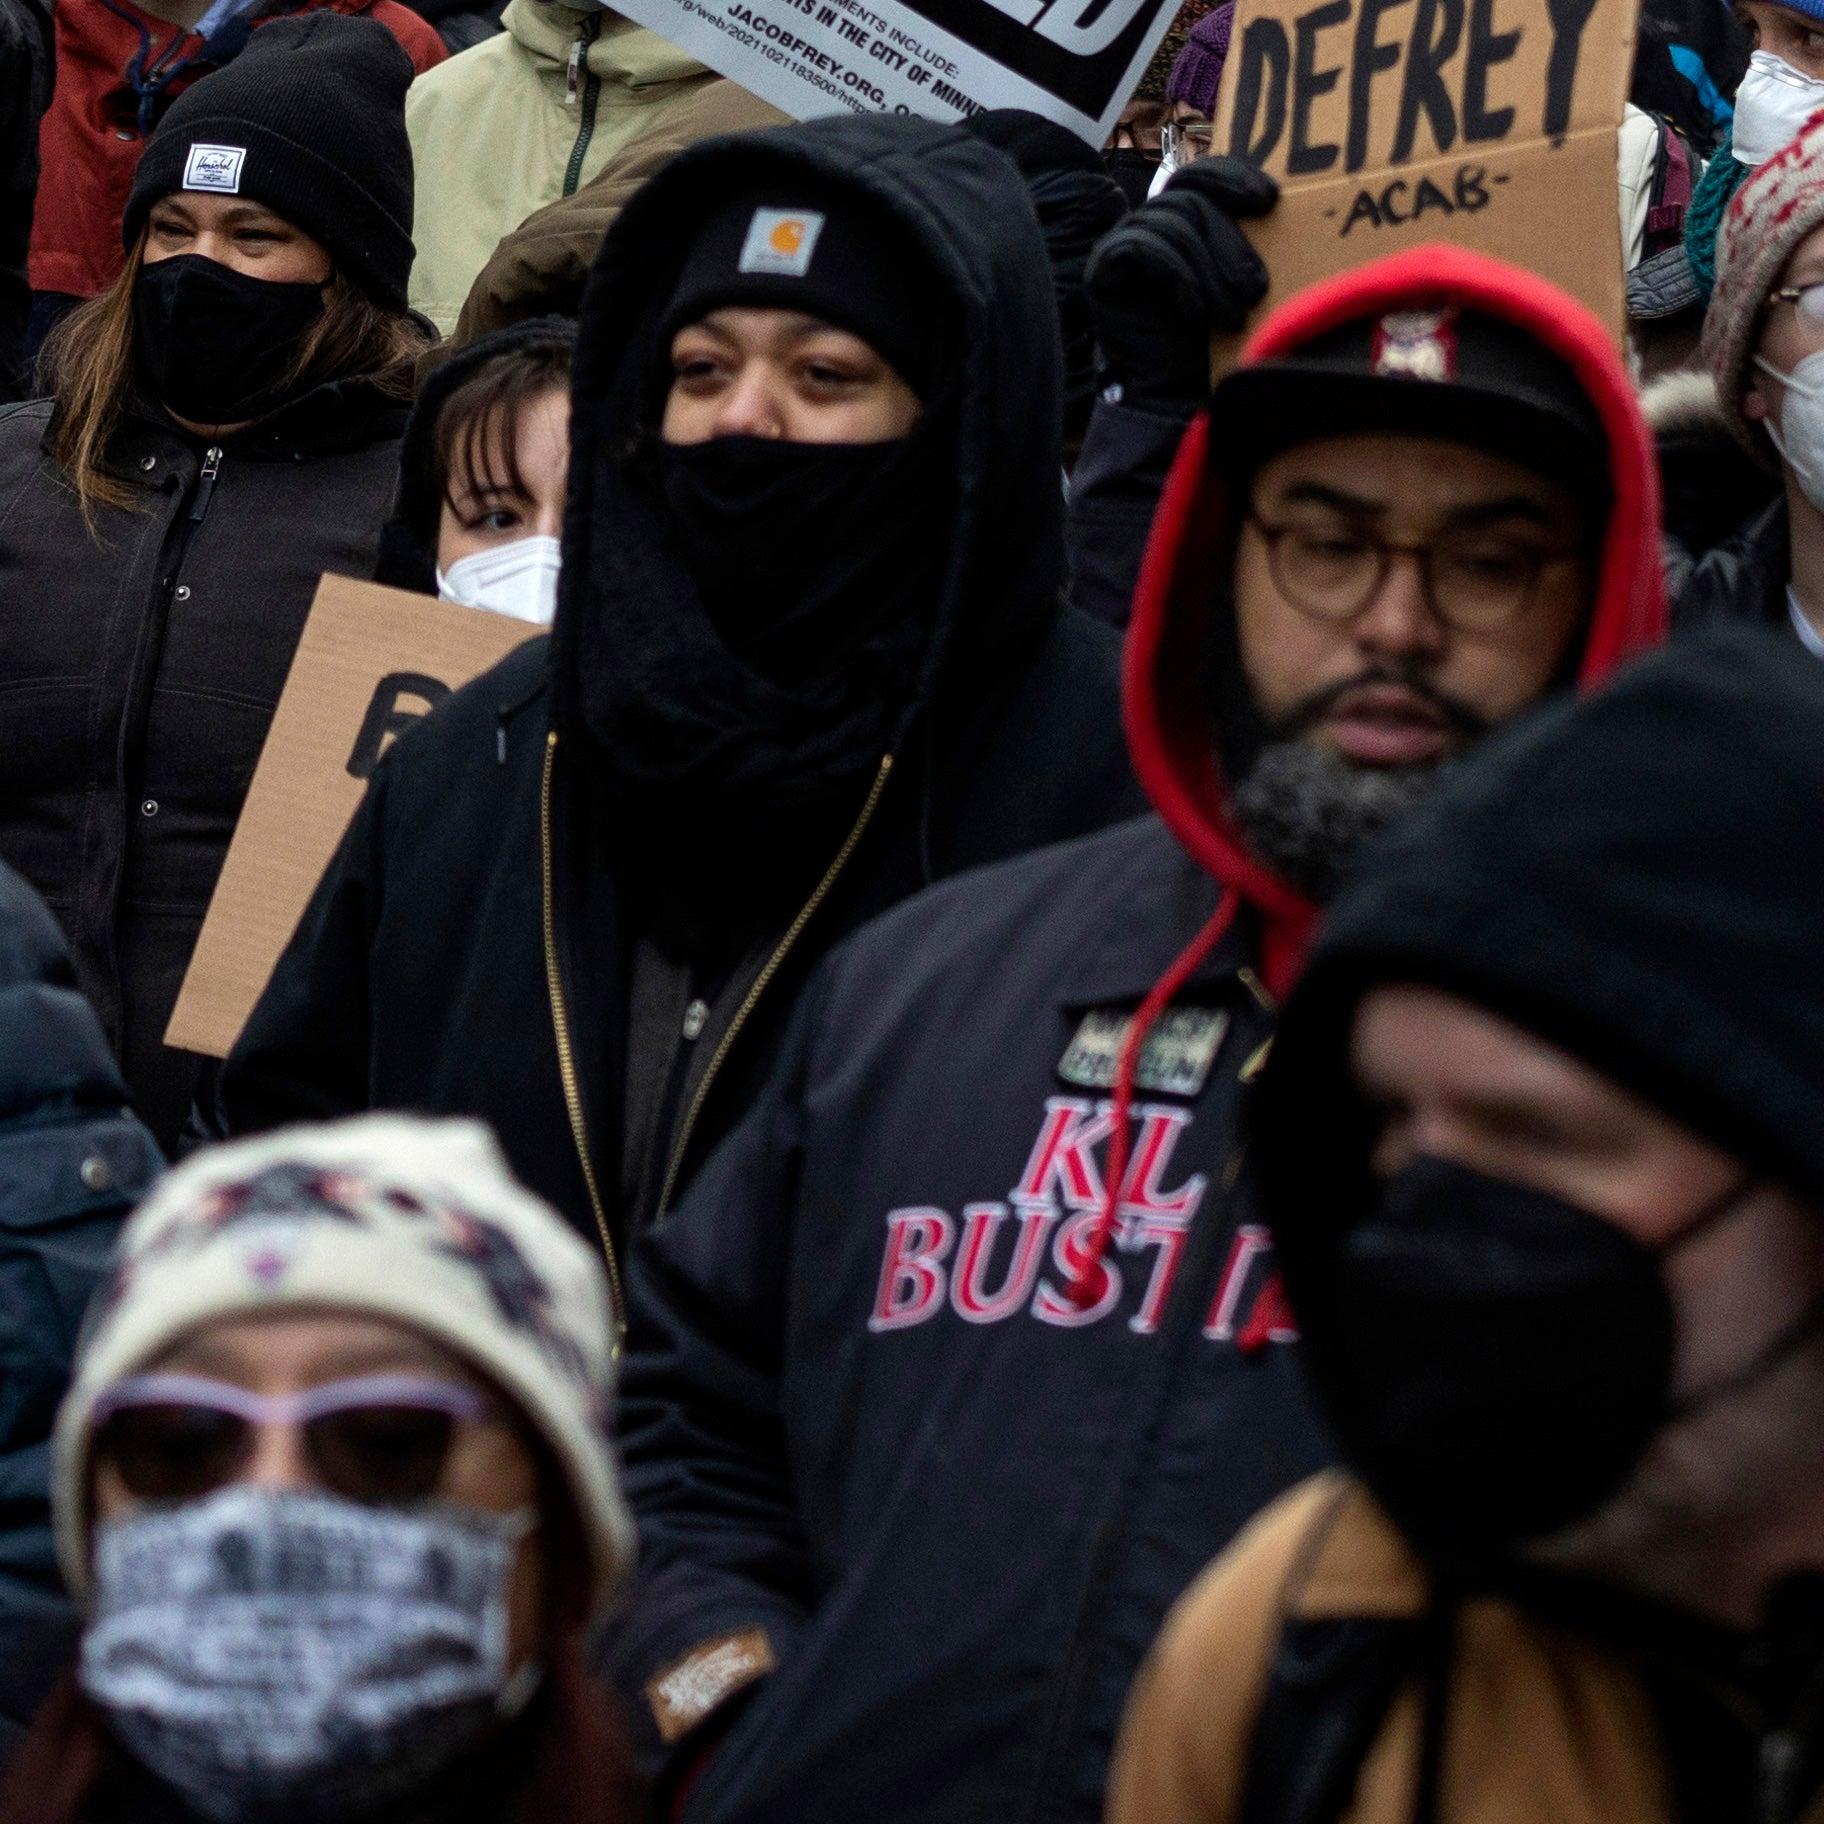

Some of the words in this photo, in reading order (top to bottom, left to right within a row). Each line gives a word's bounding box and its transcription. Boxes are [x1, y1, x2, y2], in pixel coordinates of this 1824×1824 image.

[727, 2, 887, 111] JACOBFREY.ORG,
[815, 4, 837, 28] IN
[836, 17, 872, 50] THE
[869, 40, 910, 74] CITY
[906, 63, 934, 87] OF
[888, 27, 962, 80] INCLUDE:
